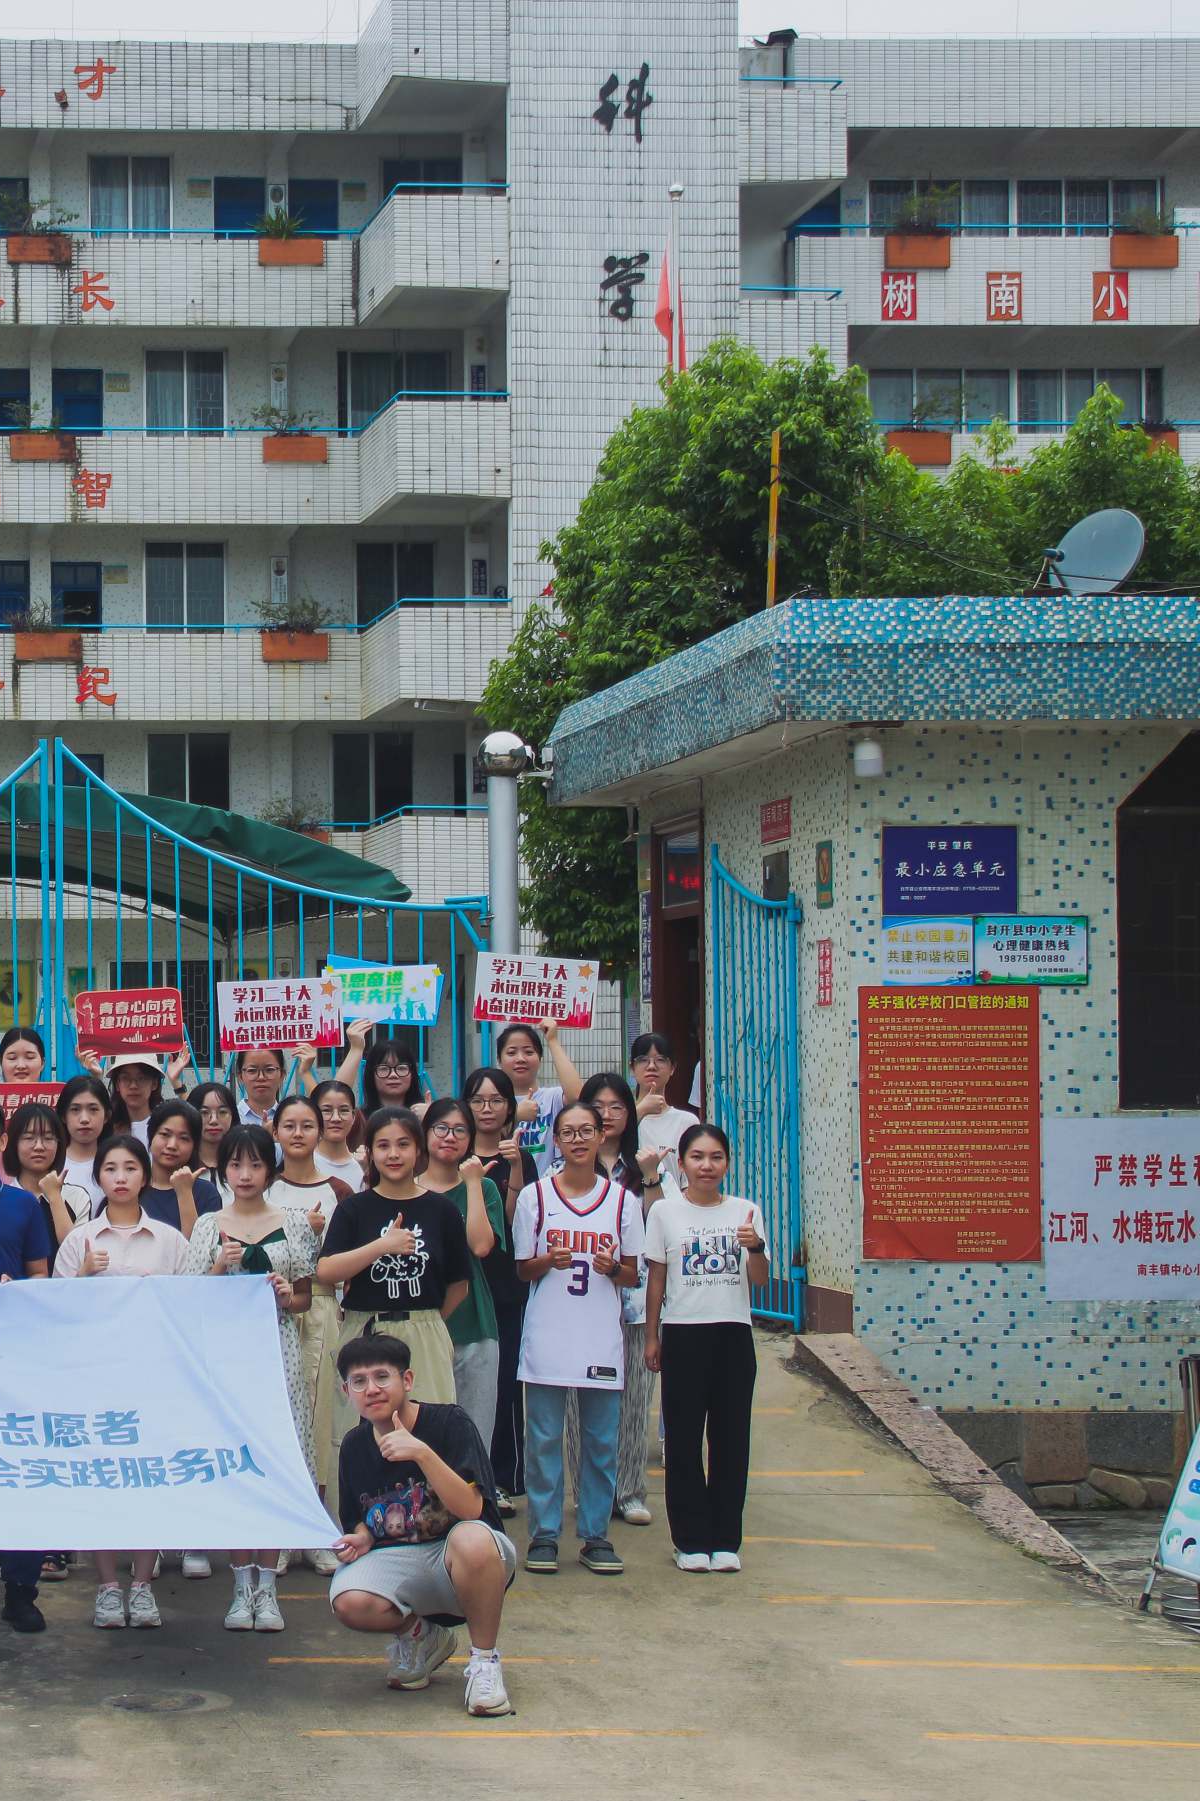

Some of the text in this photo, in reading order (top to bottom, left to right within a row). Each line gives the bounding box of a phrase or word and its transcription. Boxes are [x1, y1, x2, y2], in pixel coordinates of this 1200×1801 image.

[592, 61, 654, 323] 科学
[895, 860, 1006, 879] 最小应急单元
[887, 929, 969, 943] 禁止校园暴力
[986, 924, 1076, 937] 封开县中小学生
[992, 939, 1071, 952] 心理健康热线
[887, 950, 969, 964] 共建和谐校园
[999, 954, 1065, 963] 19875800880
[491, 957, 569, 981] 学习二十大
[232, 983, 312, 1004] 学习二十大
[340, 985, 403, 1005] 年先行
[490, 977, 568, 1000] 永远跟党走
[99, 996, 176, 1016] 青春心向党
[234, 1002, 313, 1023] 永远跟党走
[488, 997, 568, 1020] 奋进新征程
[867, 995, 1030, 1010] 关于强化学校门口管控的通知
[99, 1013, 177, 1031] 建功新时代
[234, 1021, 314, 1043] 奋进新征程
[1048, 1209, 1197, 1244] 江河、水塘玩水
[567, 1259, 591, 1297] 3
